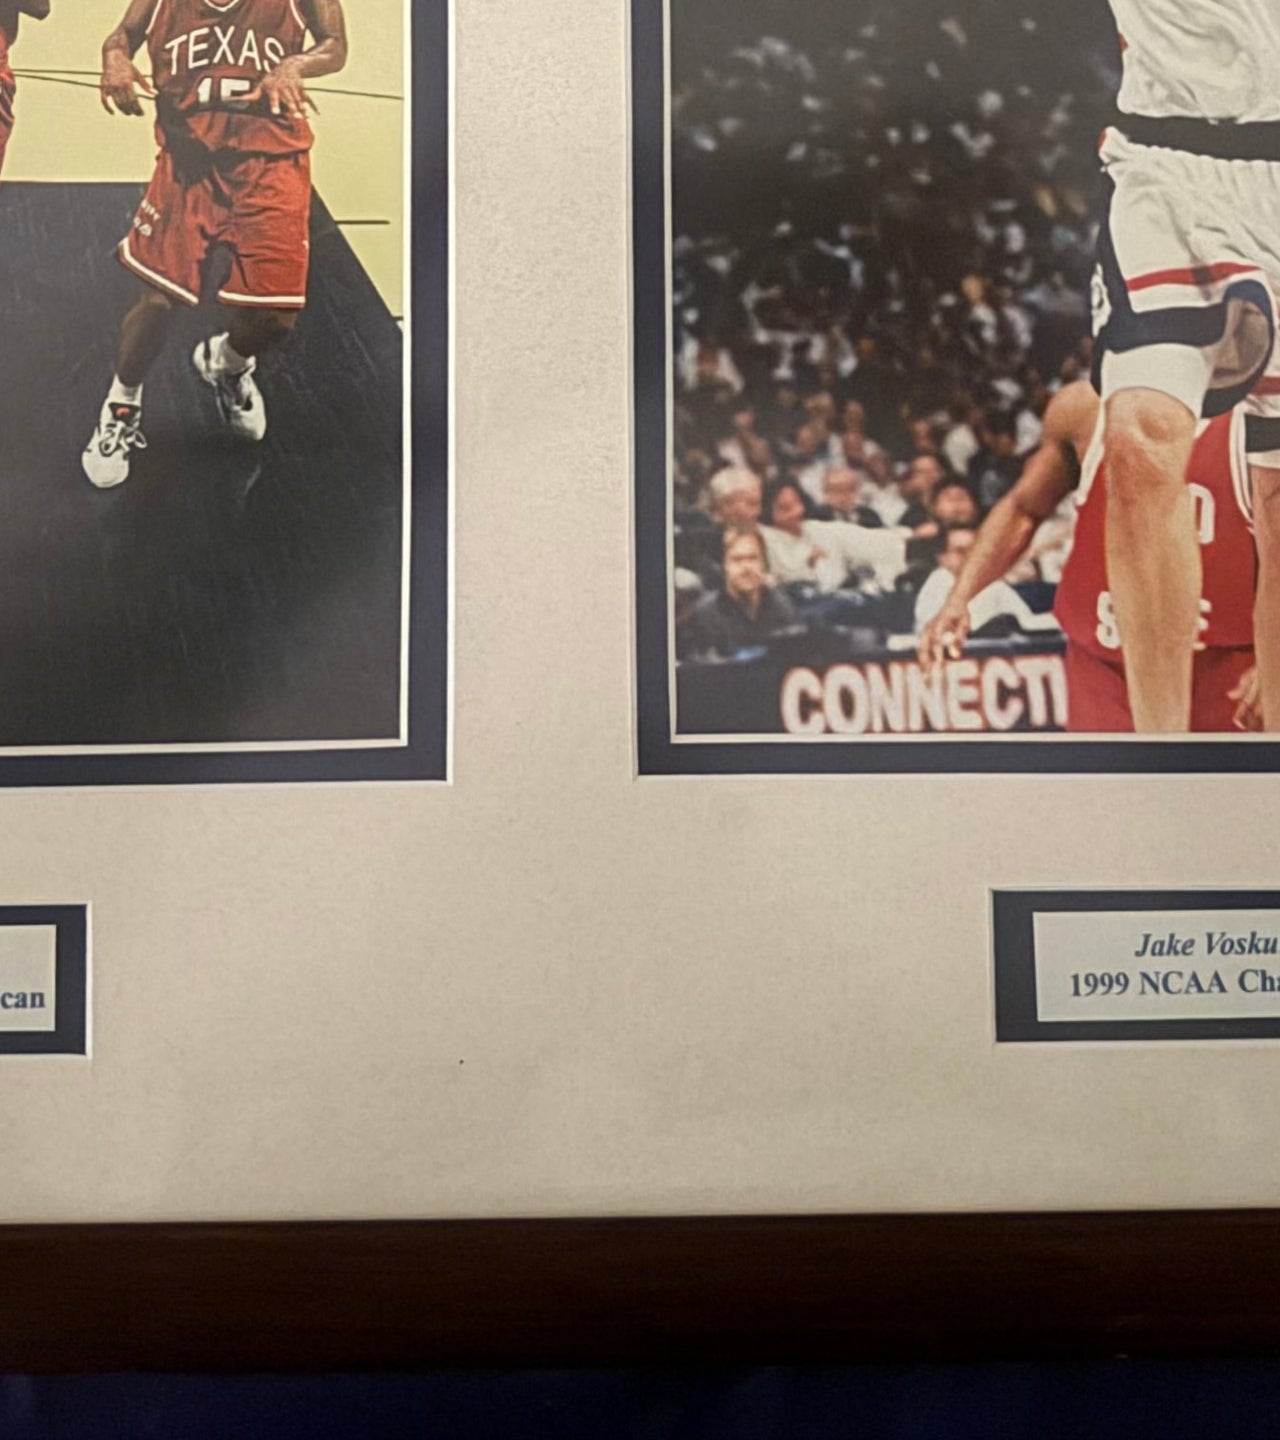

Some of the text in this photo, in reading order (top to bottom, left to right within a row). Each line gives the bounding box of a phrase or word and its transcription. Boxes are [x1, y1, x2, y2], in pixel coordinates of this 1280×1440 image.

[164, 25, 286, 76] TEXAS
[1133, 932, 1196, 958] Jake
[1069, 971, 1129, 998] 1999
[1138, 968, 1228, 995] NCAA
